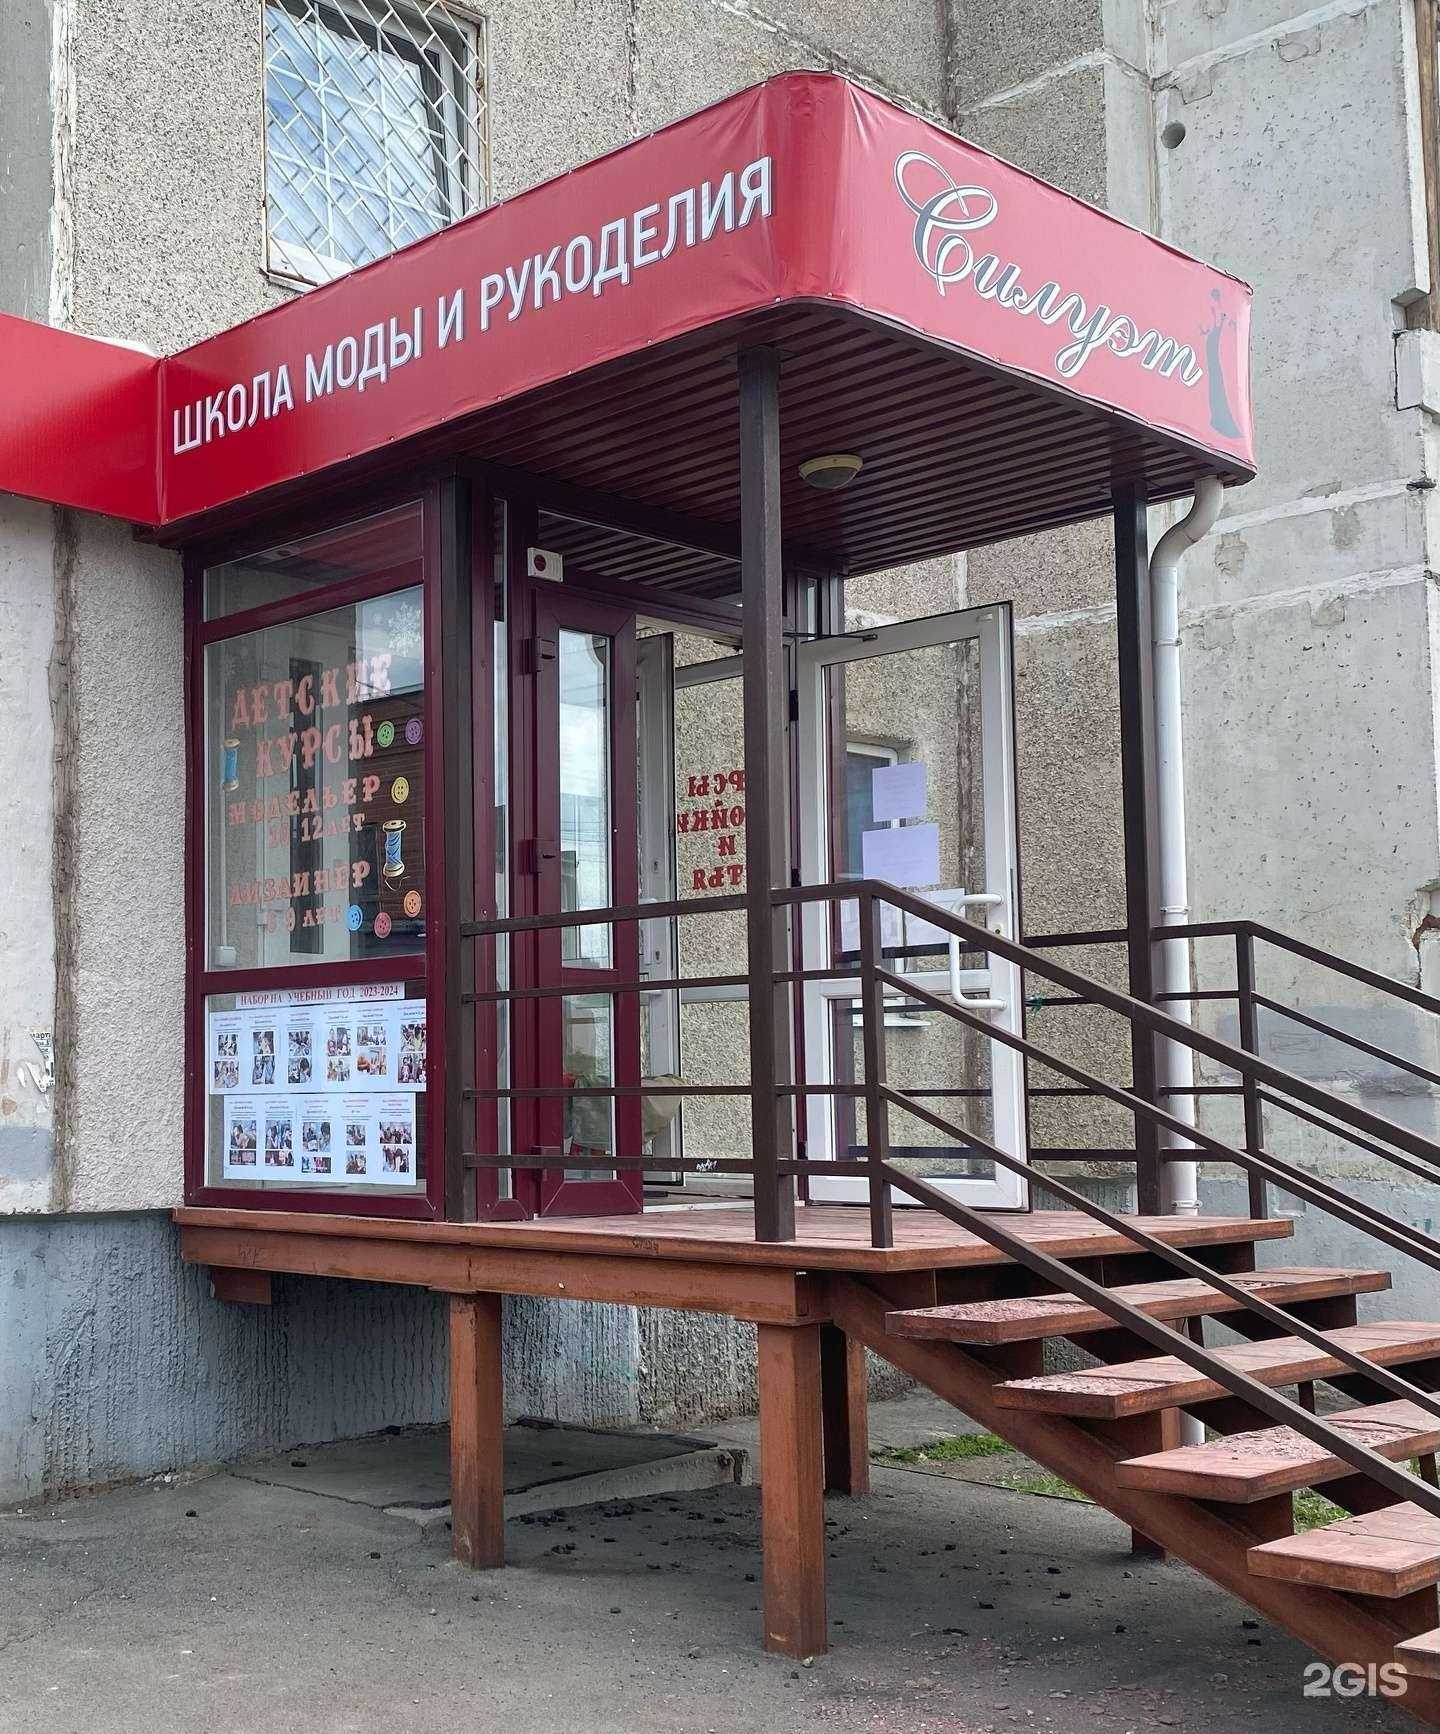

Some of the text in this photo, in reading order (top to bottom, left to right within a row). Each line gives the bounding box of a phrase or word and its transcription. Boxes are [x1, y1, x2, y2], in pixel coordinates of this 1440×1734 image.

[894, 150, 1203, 387] Силуэт
[173, 156, 773, 456] ШКОЛА МОДЫ И РУКОДЕЛИЯ
[232, 656, 391, 730] ДЕТСКИЕ
[256, 714, 374, 778] КУРСЫ
[336, 988, 356, 999] ГОД
[360, 986, 399, 998] 2023-2024
